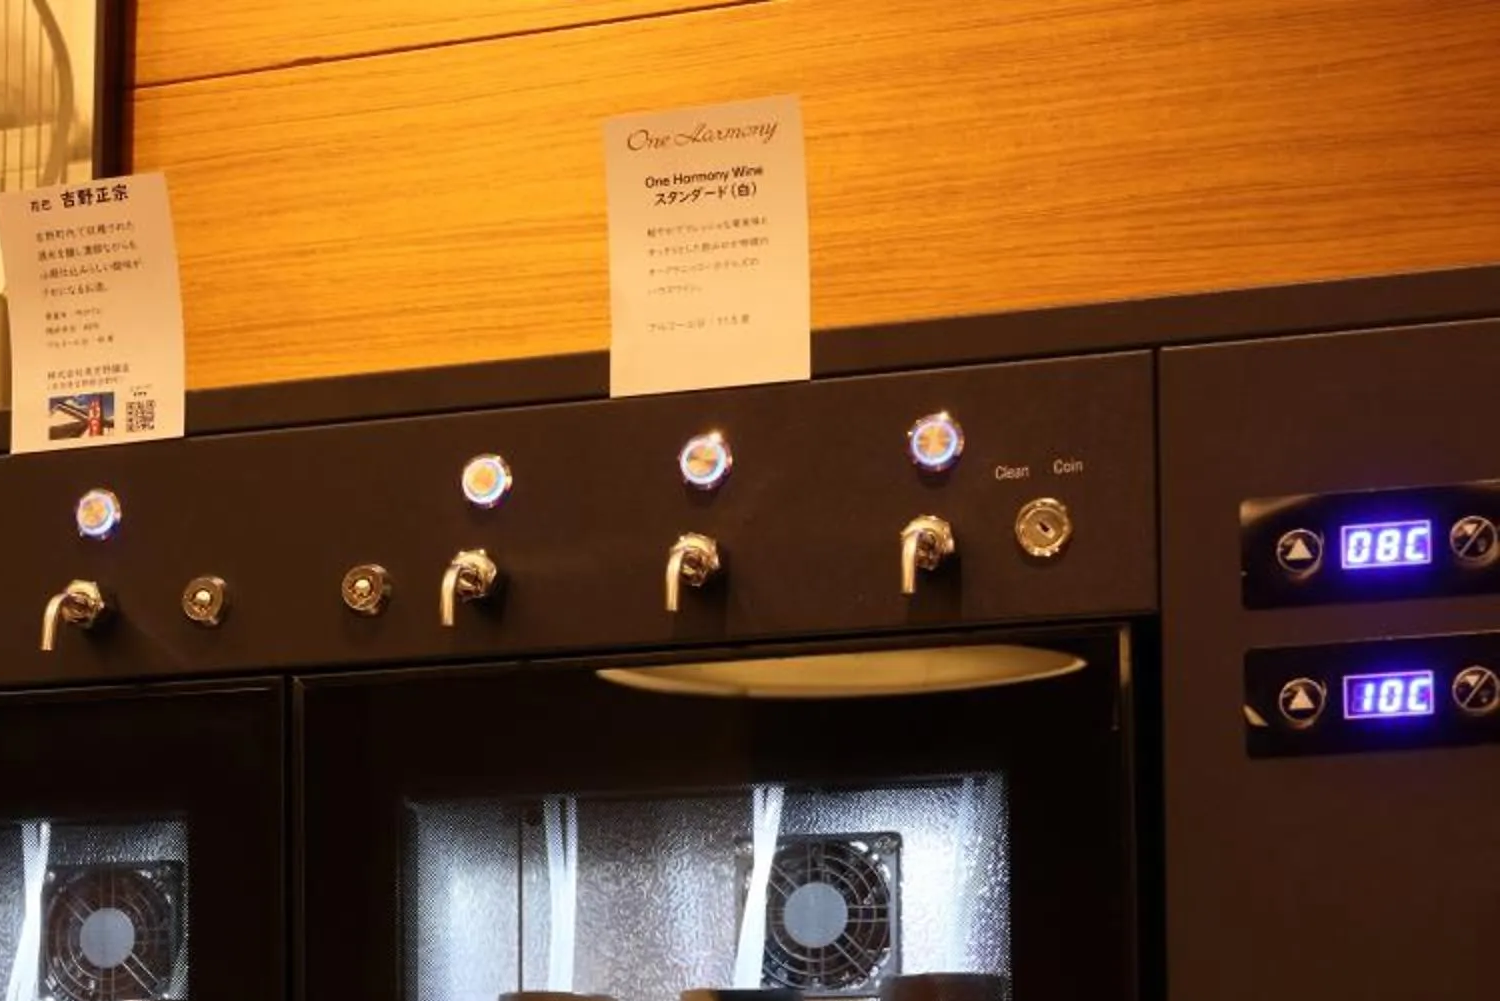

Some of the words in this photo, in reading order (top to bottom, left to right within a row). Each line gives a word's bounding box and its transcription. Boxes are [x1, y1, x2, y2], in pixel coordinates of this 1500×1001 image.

[627, 128, 671, 151] One
[673, 120, 780, 147] Harmony
[645, 175, 670, 189] One
[672, 169, 730, 188] Harmony
[731, 165, 764, 179] Wine
[60, 183, 130, 209] 吉野正宗
[995, 465, 1030, 481] Clean
[1053, 458, 1084, 475] Coin
